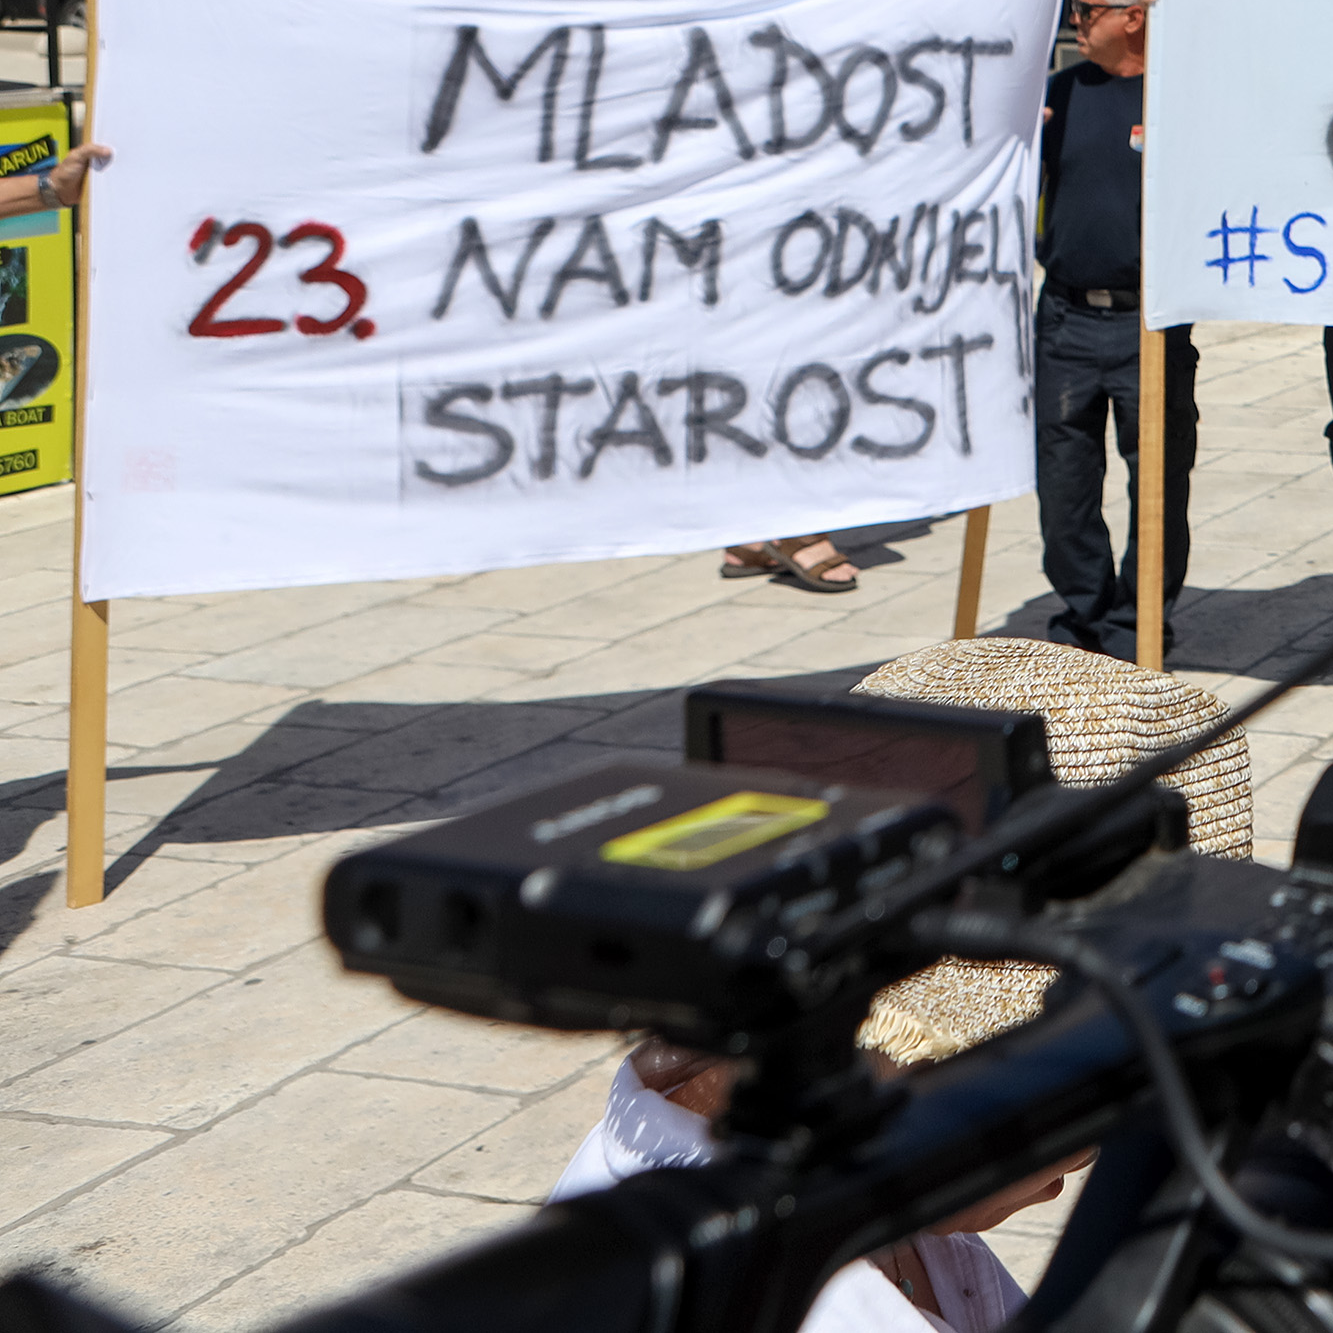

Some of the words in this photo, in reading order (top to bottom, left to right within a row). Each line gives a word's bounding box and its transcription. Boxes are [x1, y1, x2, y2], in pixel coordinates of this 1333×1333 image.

[420, 22, 1014, 171] MLADOST
[0, 140, 50, 176] ARUN
[431, 216, 725, 319] NAM
[6, 408, 46, 426] BOAT
